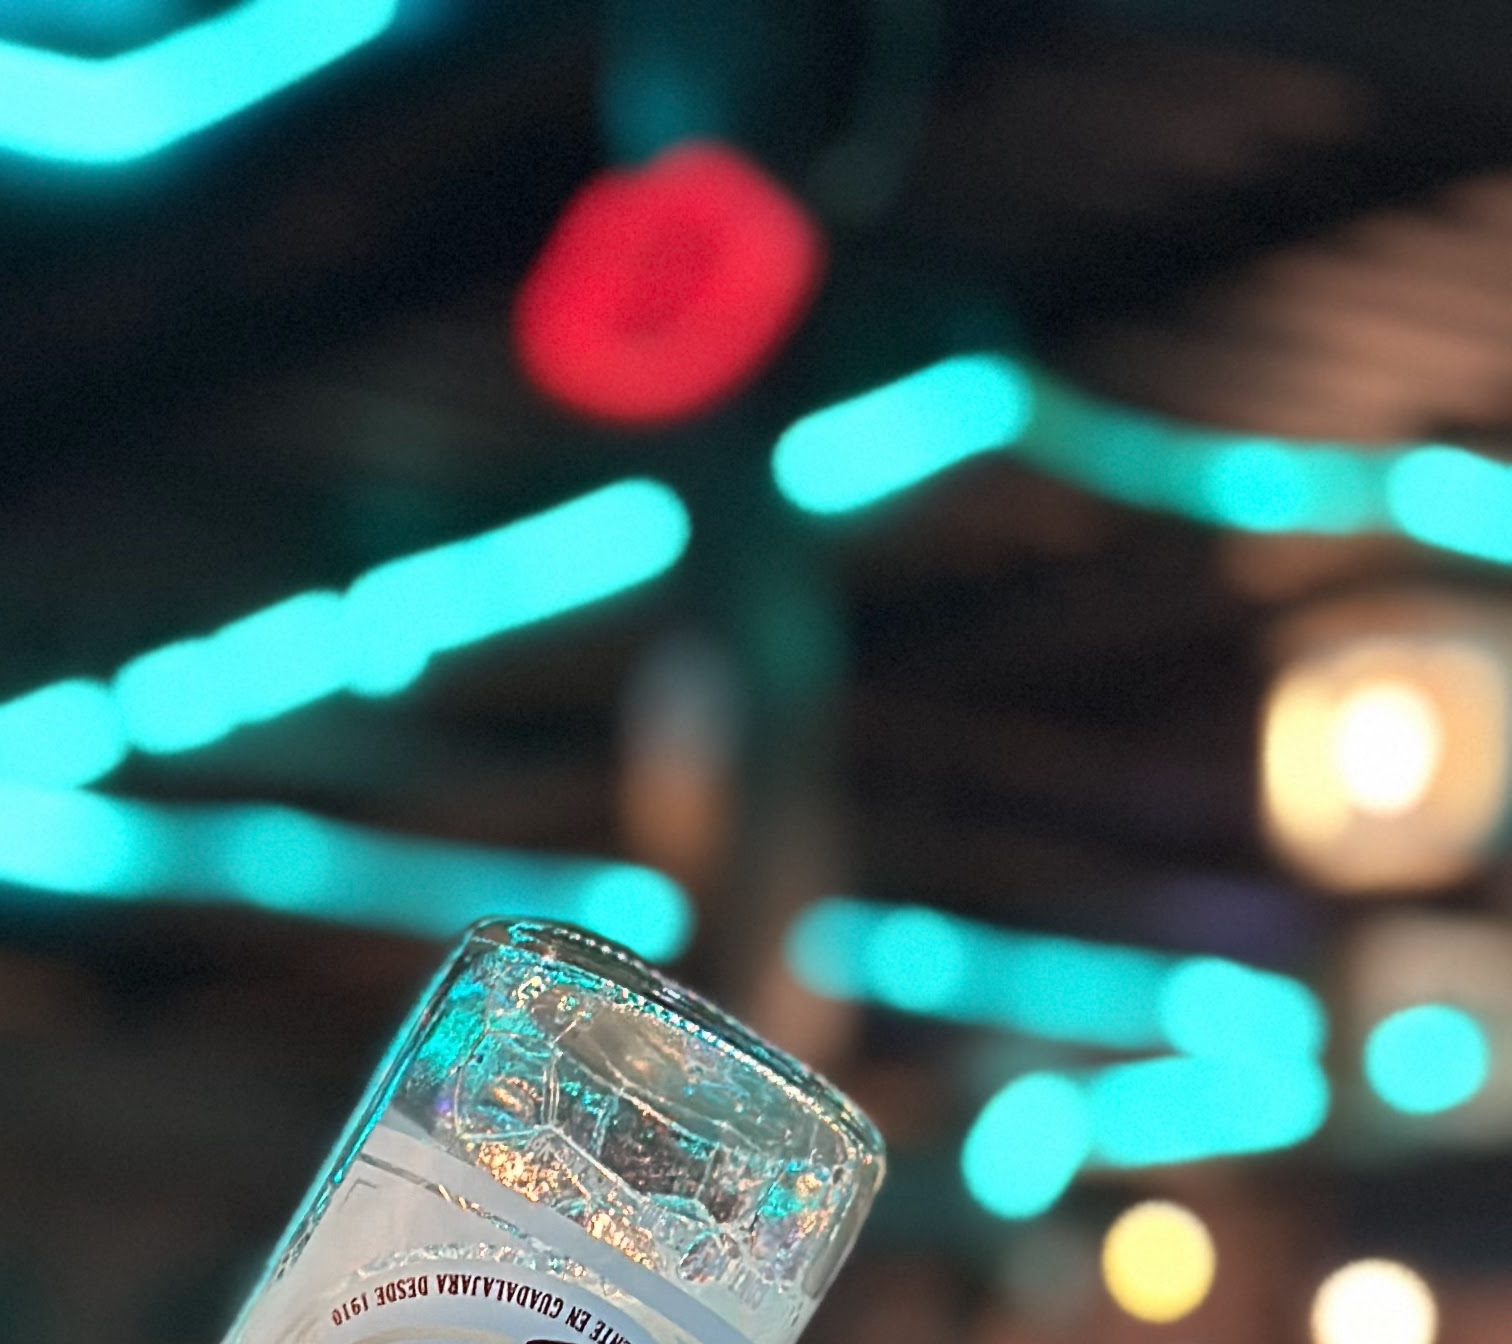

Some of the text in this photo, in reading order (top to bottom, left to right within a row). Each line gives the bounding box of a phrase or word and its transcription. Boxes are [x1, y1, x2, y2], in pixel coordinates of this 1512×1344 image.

[374, 1275, 429, 1306] DESDE
[436, 1273, 564, 1319] GUADALAJARA
[331, 1291, 369, 1326] 1910
[565, 1305, 592, 1333] EN
